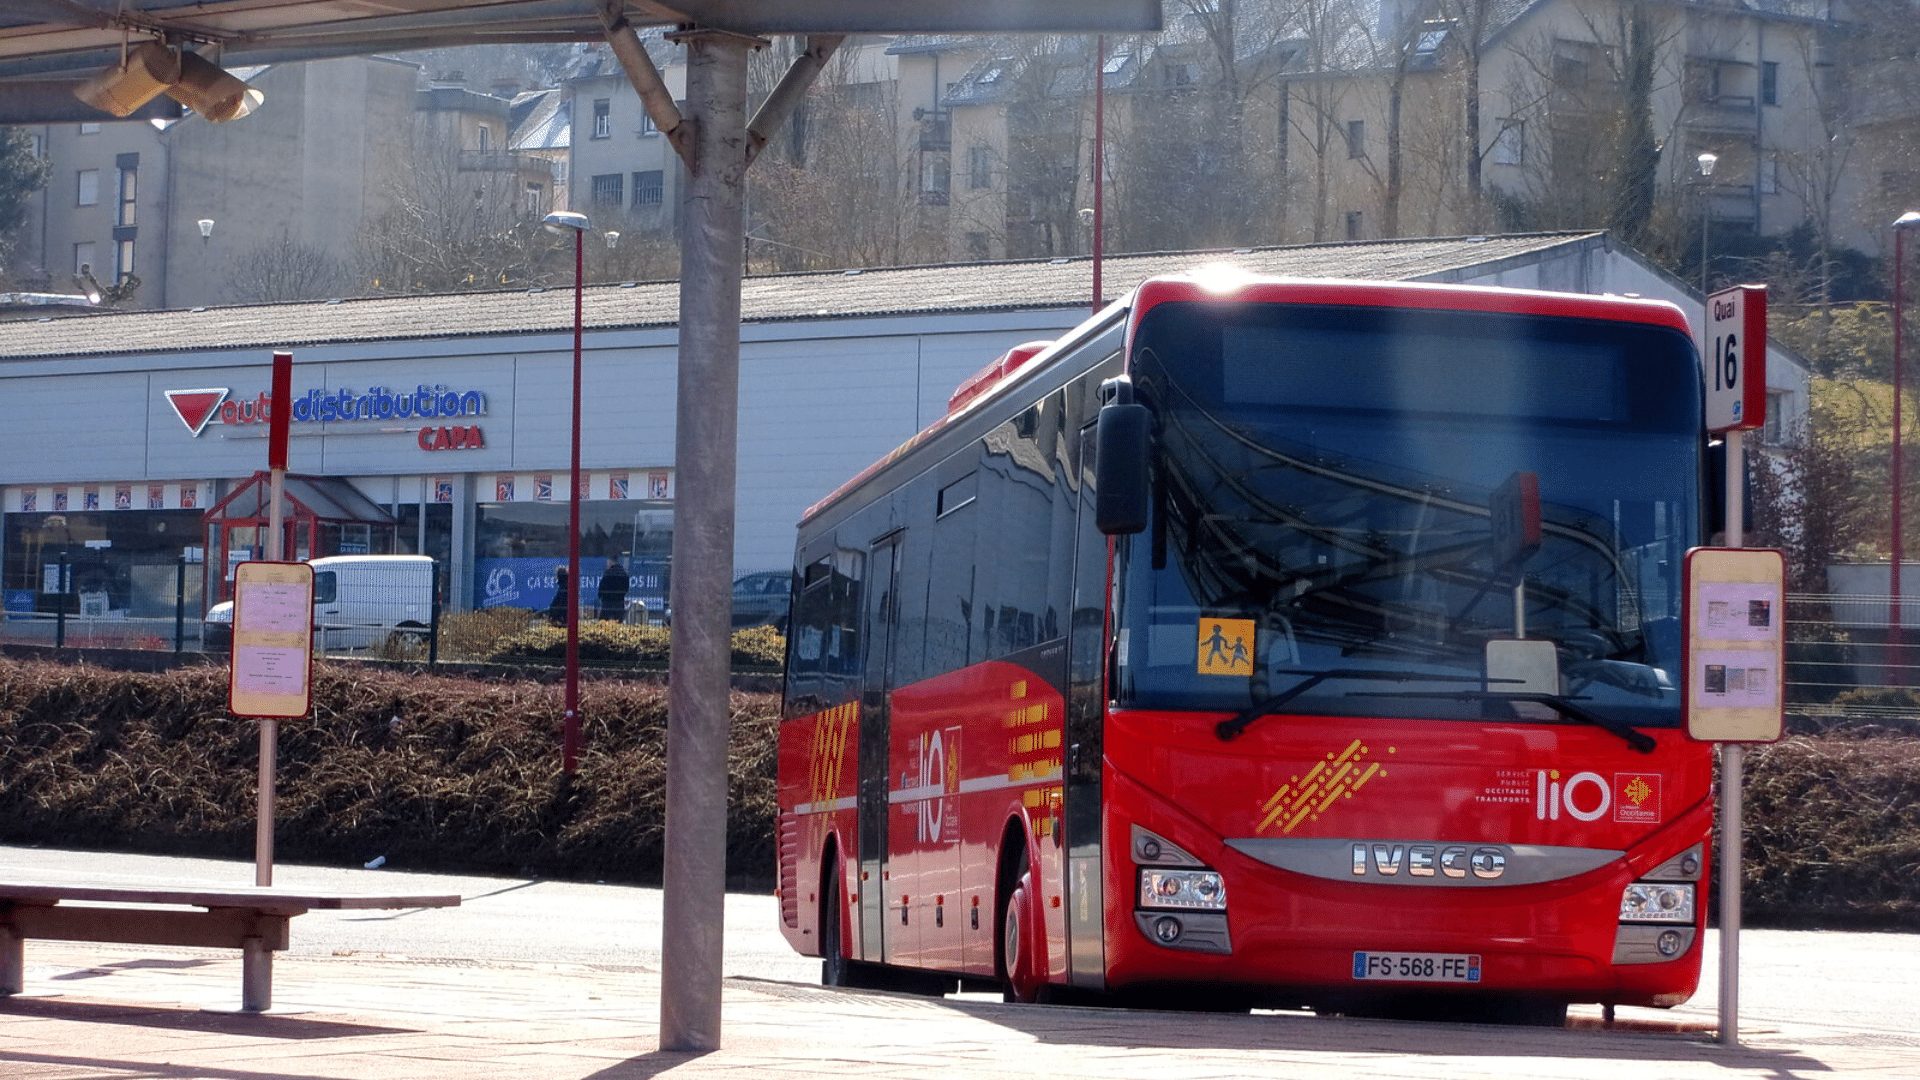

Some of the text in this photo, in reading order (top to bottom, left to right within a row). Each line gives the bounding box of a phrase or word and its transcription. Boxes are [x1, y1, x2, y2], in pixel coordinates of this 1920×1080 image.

[1714, 296, 1735, 321] Quai
[1715, 333, 1737, 391] 16
[220, 384, 486, 424] autdistribution
[417, 425, 485, 450] CAPA
[1475, 795, 1530, 803] TRANSPORTS
[1485, 787, 1530, 795] OCCITANIE
[1352, 844, 1506, 880] IVECO
